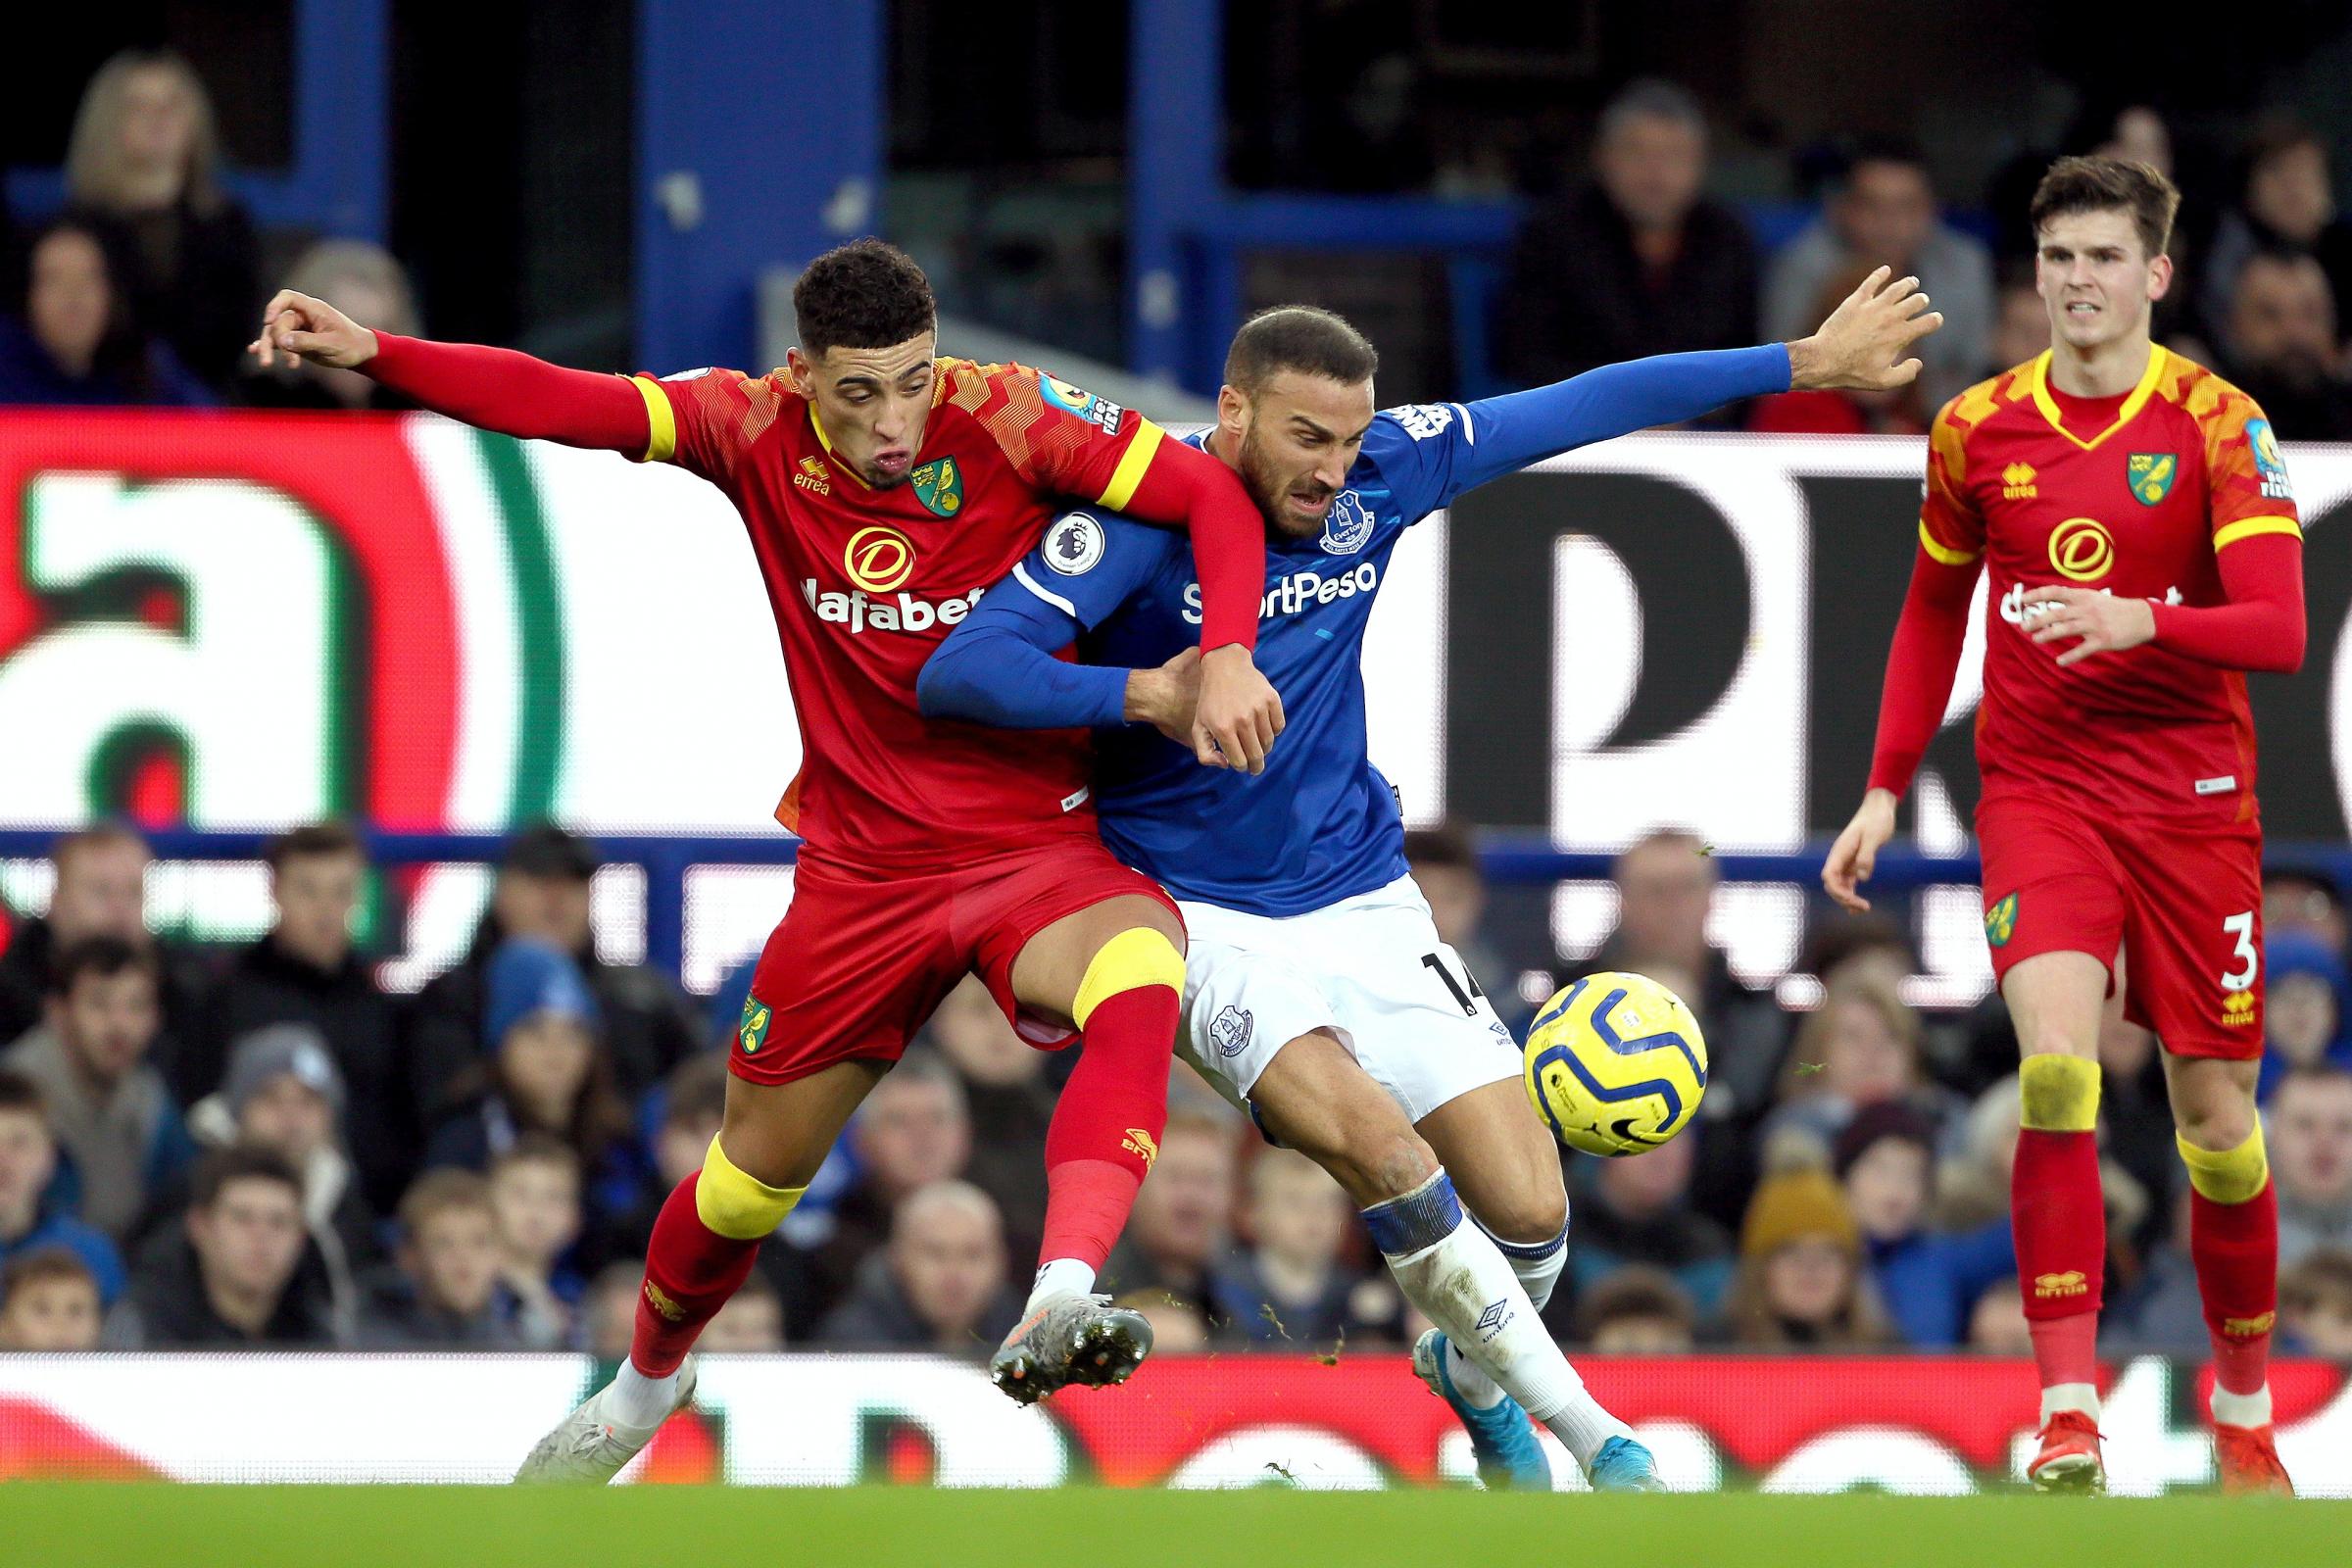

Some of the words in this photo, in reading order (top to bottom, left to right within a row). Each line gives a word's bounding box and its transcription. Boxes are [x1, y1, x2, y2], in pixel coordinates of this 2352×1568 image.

[794, 473, 830, 497] errea
[1334, 522, 1364, 541] Everton
[1181, 562, 1377, 625] SrtPesa
[2220, 910, 2258, 992] 3
[1483, 1311, 1515, 1344] umbro
